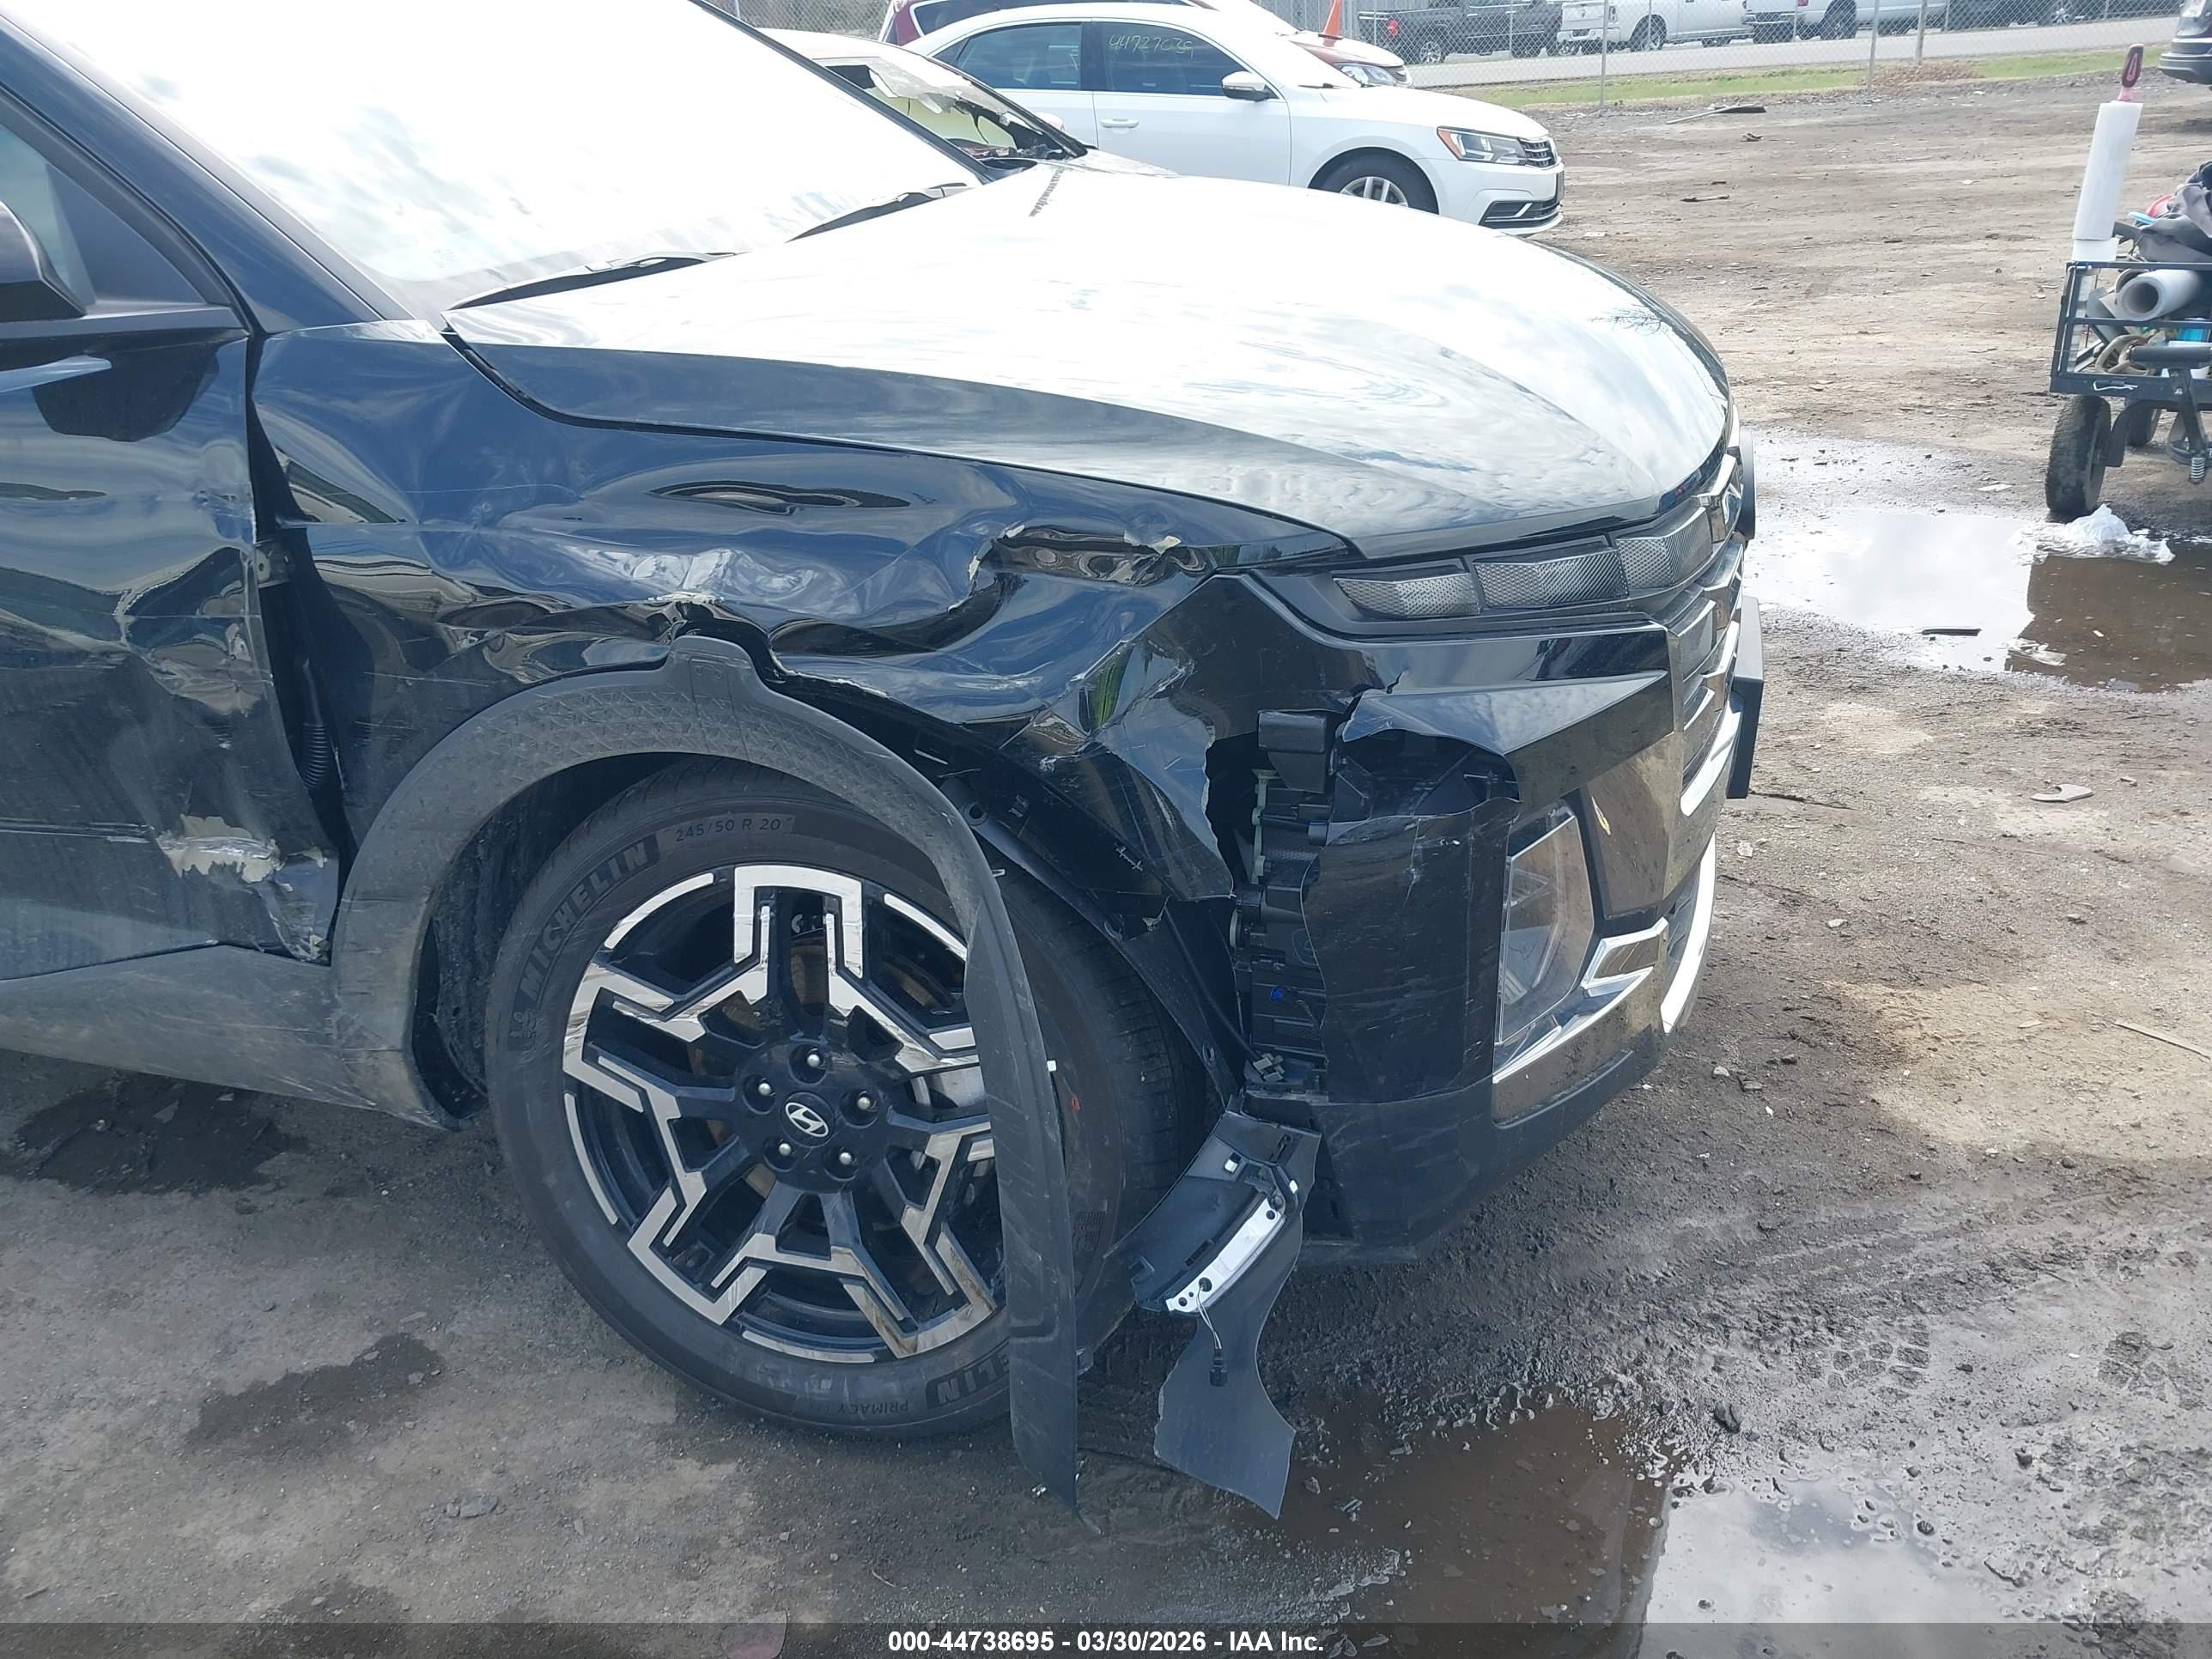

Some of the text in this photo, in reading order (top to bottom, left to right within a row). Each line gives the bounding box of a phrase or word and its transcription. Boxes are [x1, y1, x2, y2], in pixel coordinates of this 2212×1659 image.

[674, 817, 781, 842] 245/50 R 20
[520, 841, 651, 1002] MICHELIN
[837, 1401, 908, 1416] PRIMACY
